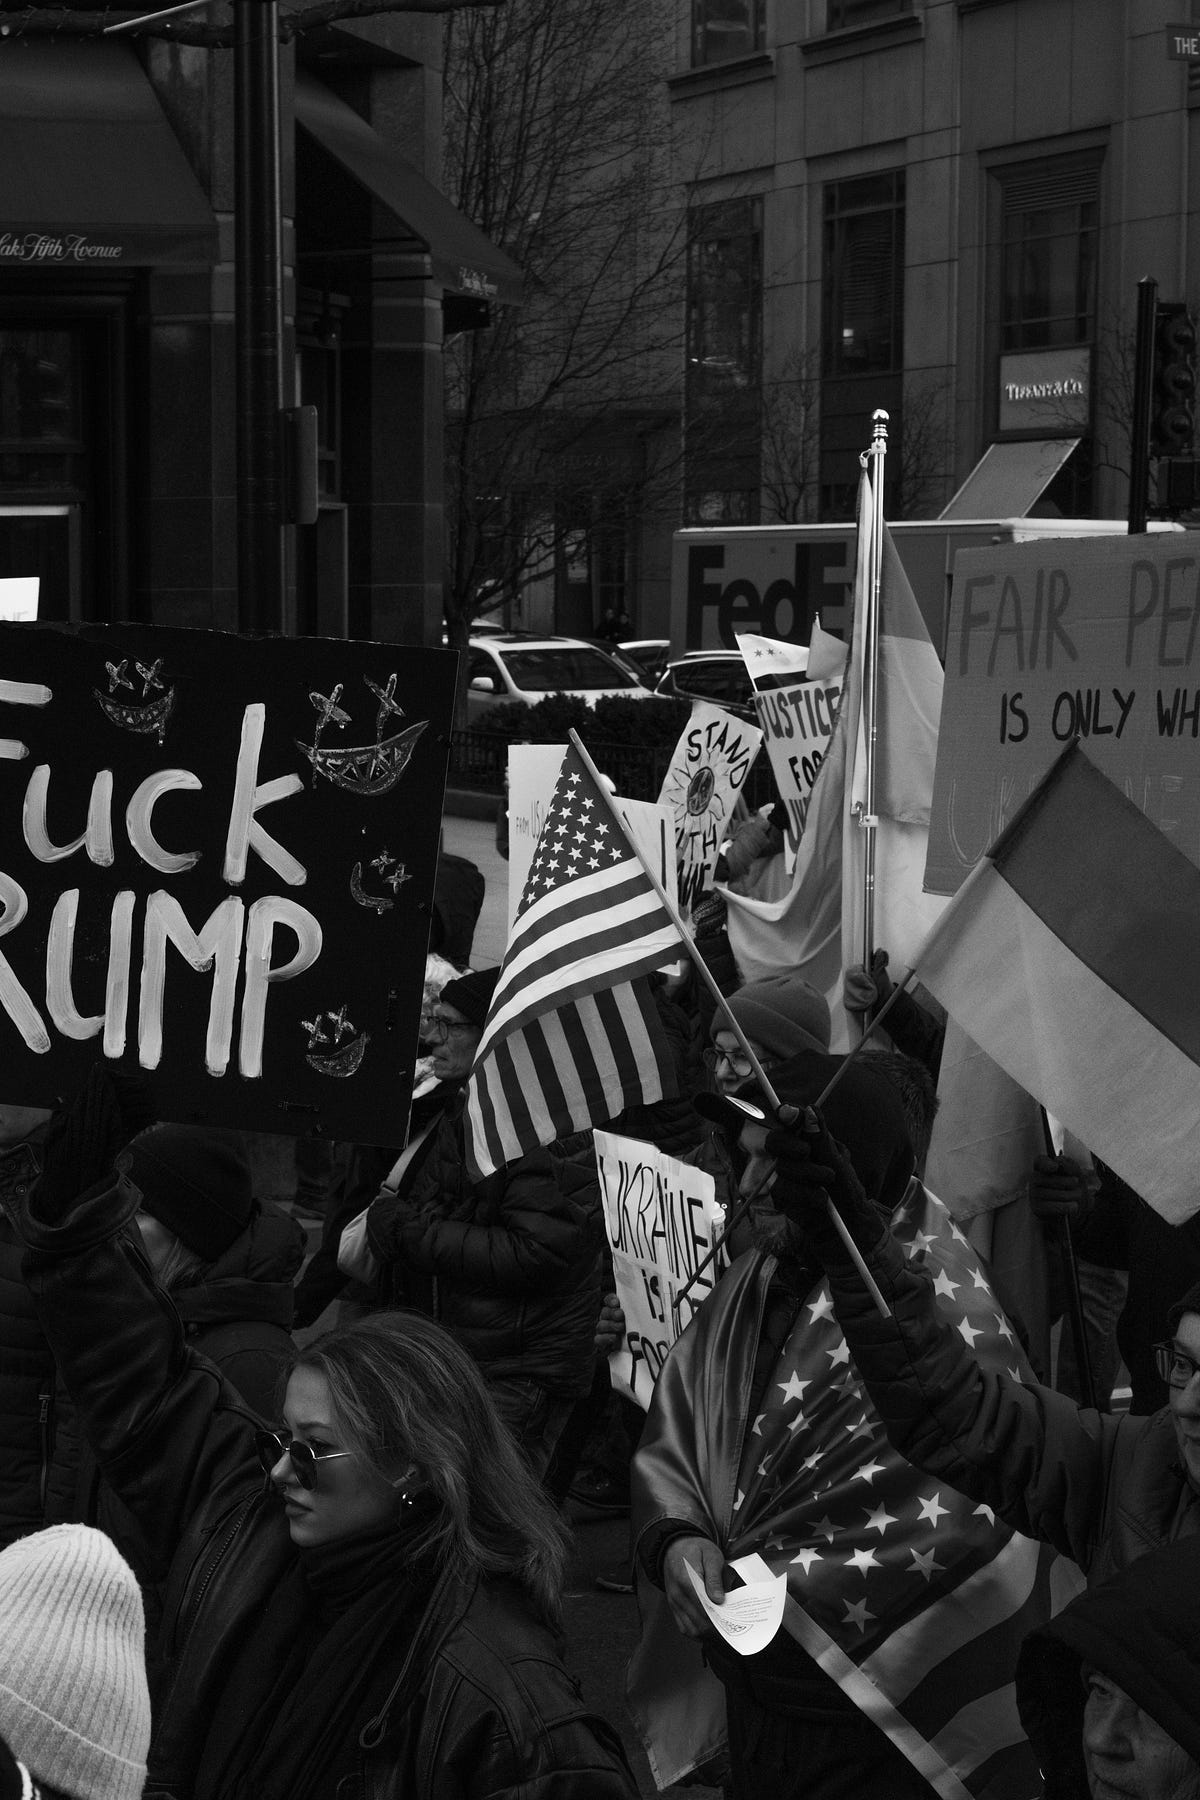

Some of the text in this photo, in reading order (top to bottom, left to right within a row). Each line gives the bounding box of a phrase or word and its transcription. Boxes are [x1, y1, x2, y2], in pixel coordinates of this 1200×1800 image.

[1173, 36, 1200, 55] THE
[19, 233, 63, 261] Fifth
[53, 234, 123, 262] Avenue
[686, 542, 853, 650] FedE
[959, 567, 1080, 678] FAIR
[1000, 691, 1029, 744] IS
[1051, 687, 1136, 741] ONLY
[687, 720, 751, 790] STAND
